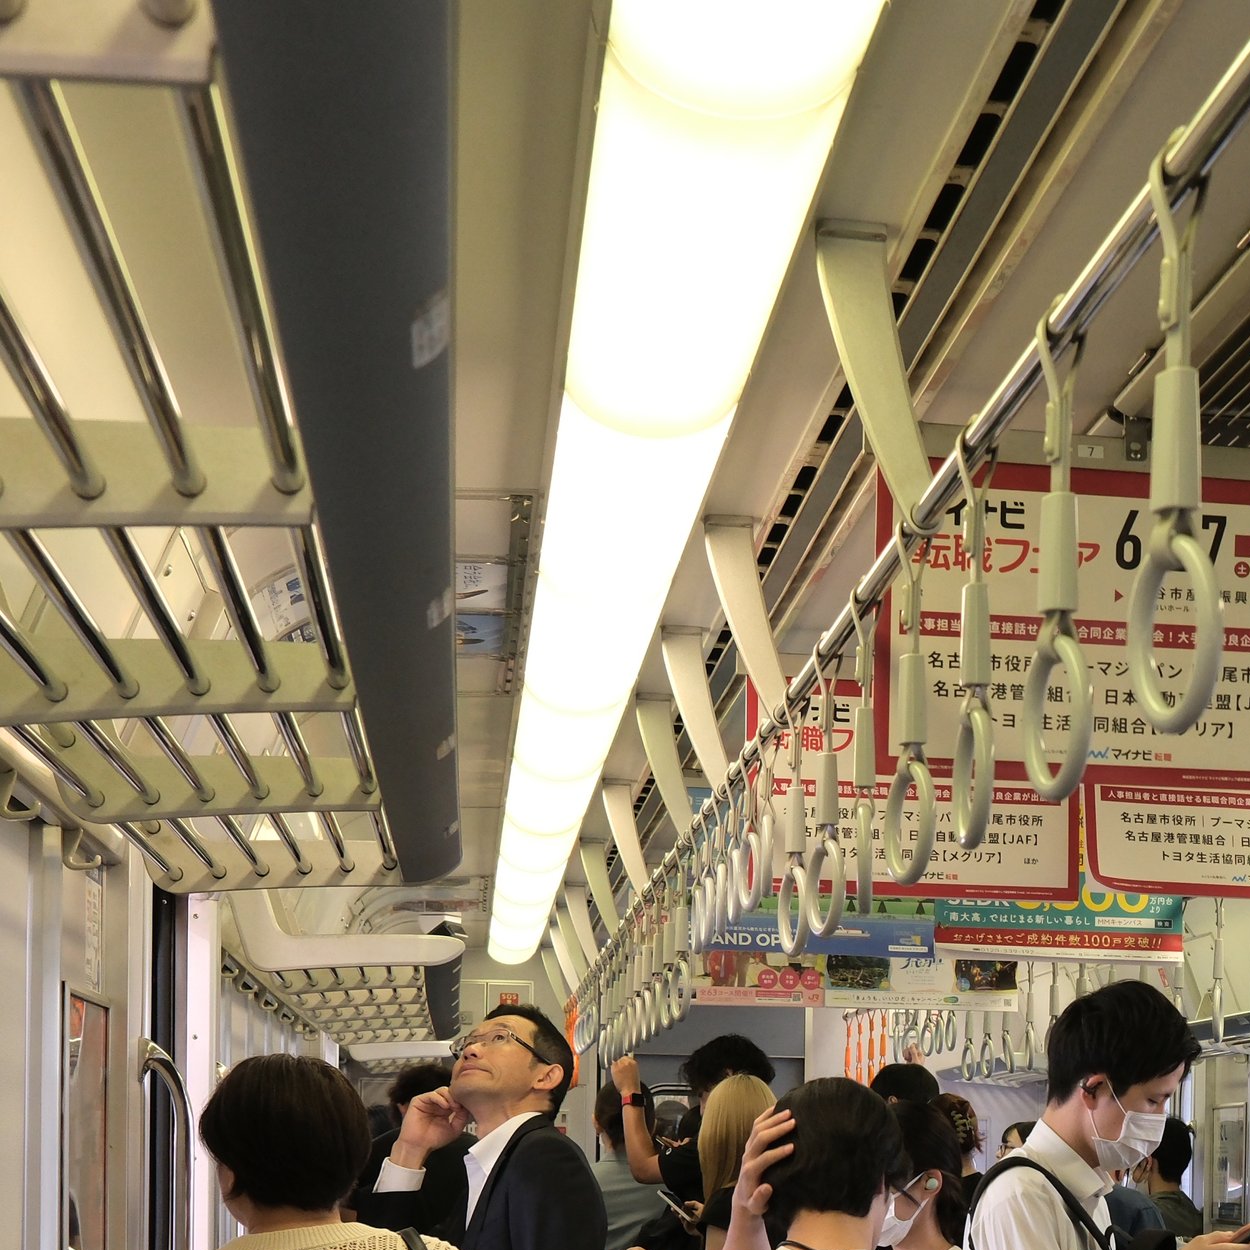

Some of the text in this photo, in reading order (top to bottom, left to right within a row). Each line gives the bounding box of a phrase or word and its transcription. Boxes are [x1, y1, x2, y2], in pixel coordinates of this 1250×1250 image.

[1087, 446, 1095, 457] 7
[987, 812, 1044, 828] 尾市役所
[1120, 810, 1197, 827] 名古屋市役所
[1124, 829, 1226, 847] 名古屋港管理組合
[1023, 856, 1039, 866] ほか
[1149, 896, 1174, 906] 万円台
[1149, 905, 1161, 914] より
[797, 993, 820, 1002] JR
